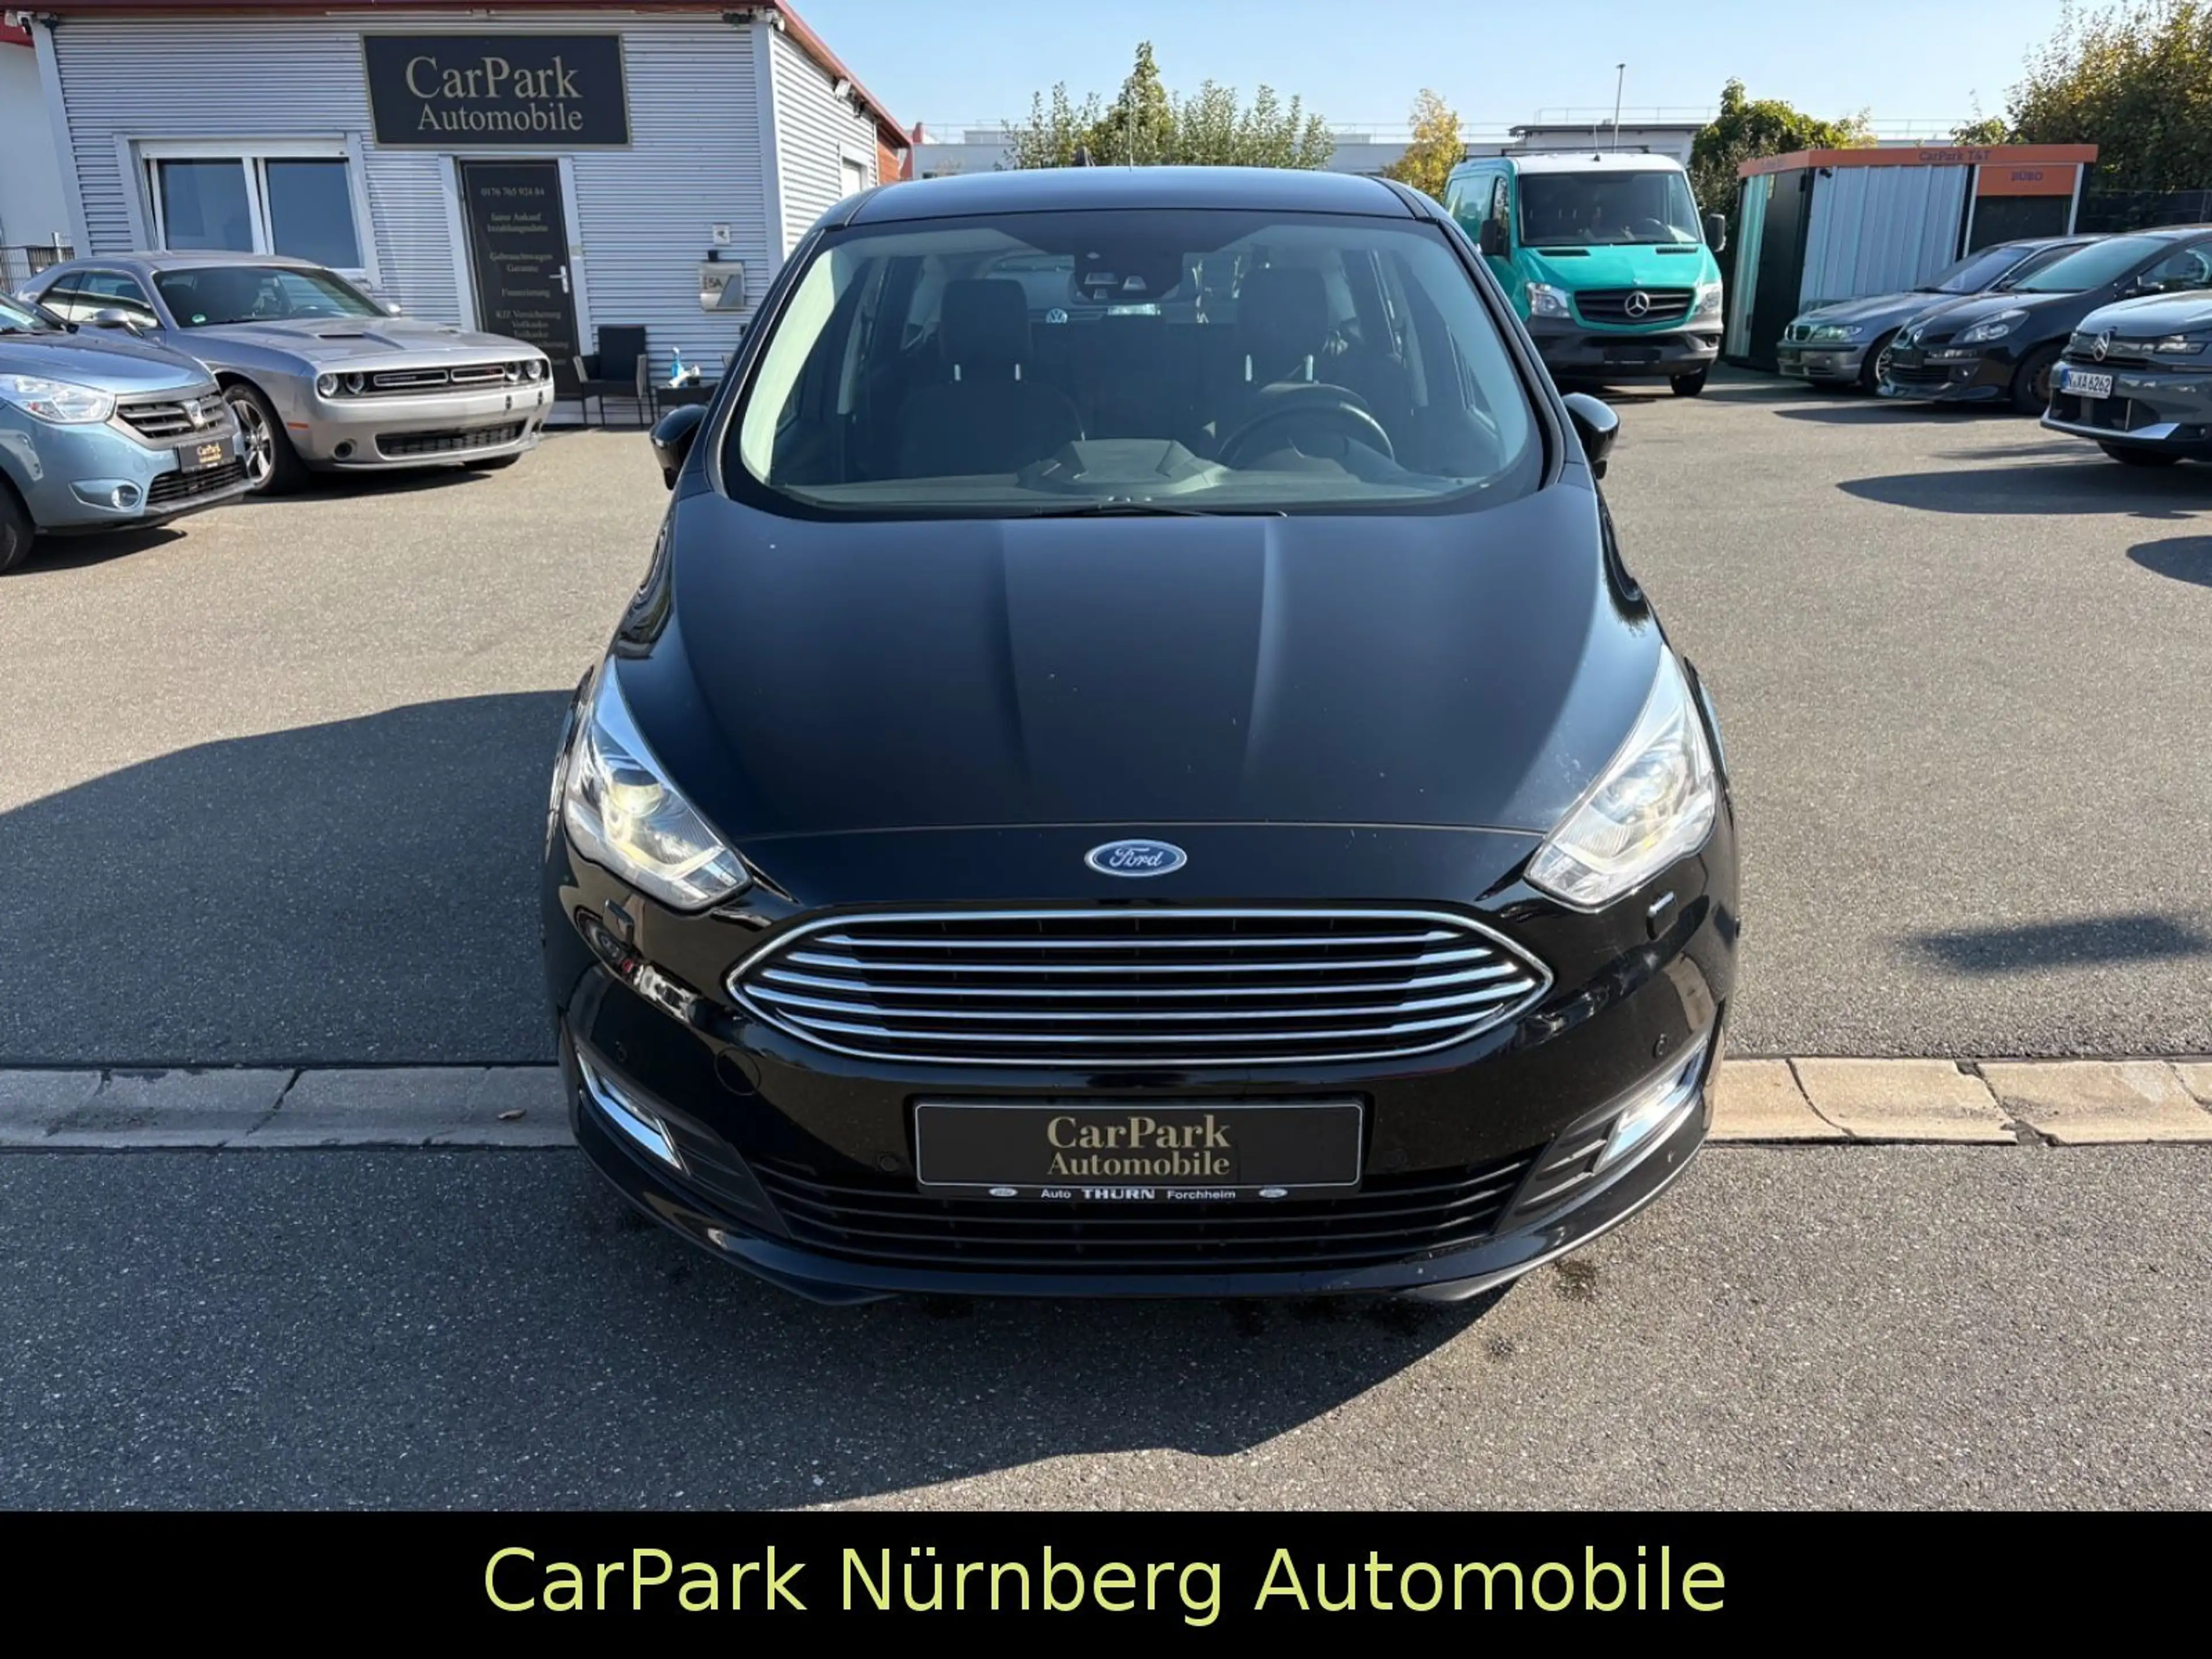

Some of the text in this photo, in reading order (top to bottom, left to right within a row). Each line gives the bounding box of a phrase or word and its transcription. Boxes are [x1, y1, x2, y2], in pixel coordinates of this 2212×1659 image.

[406, 55, 583, 99] CarPark
[417, 103, 584, 131] Automobile
[1919, 150, 1963, 161] CarPark
[1109, 847, 1165, 868] Ford
[1047, 1114, 1230, 1148] CarPark
[1047, 1150, 1230, 1175] Automobile
[1040, 1188, 1236, 1200] Auto THURN Forchheim
